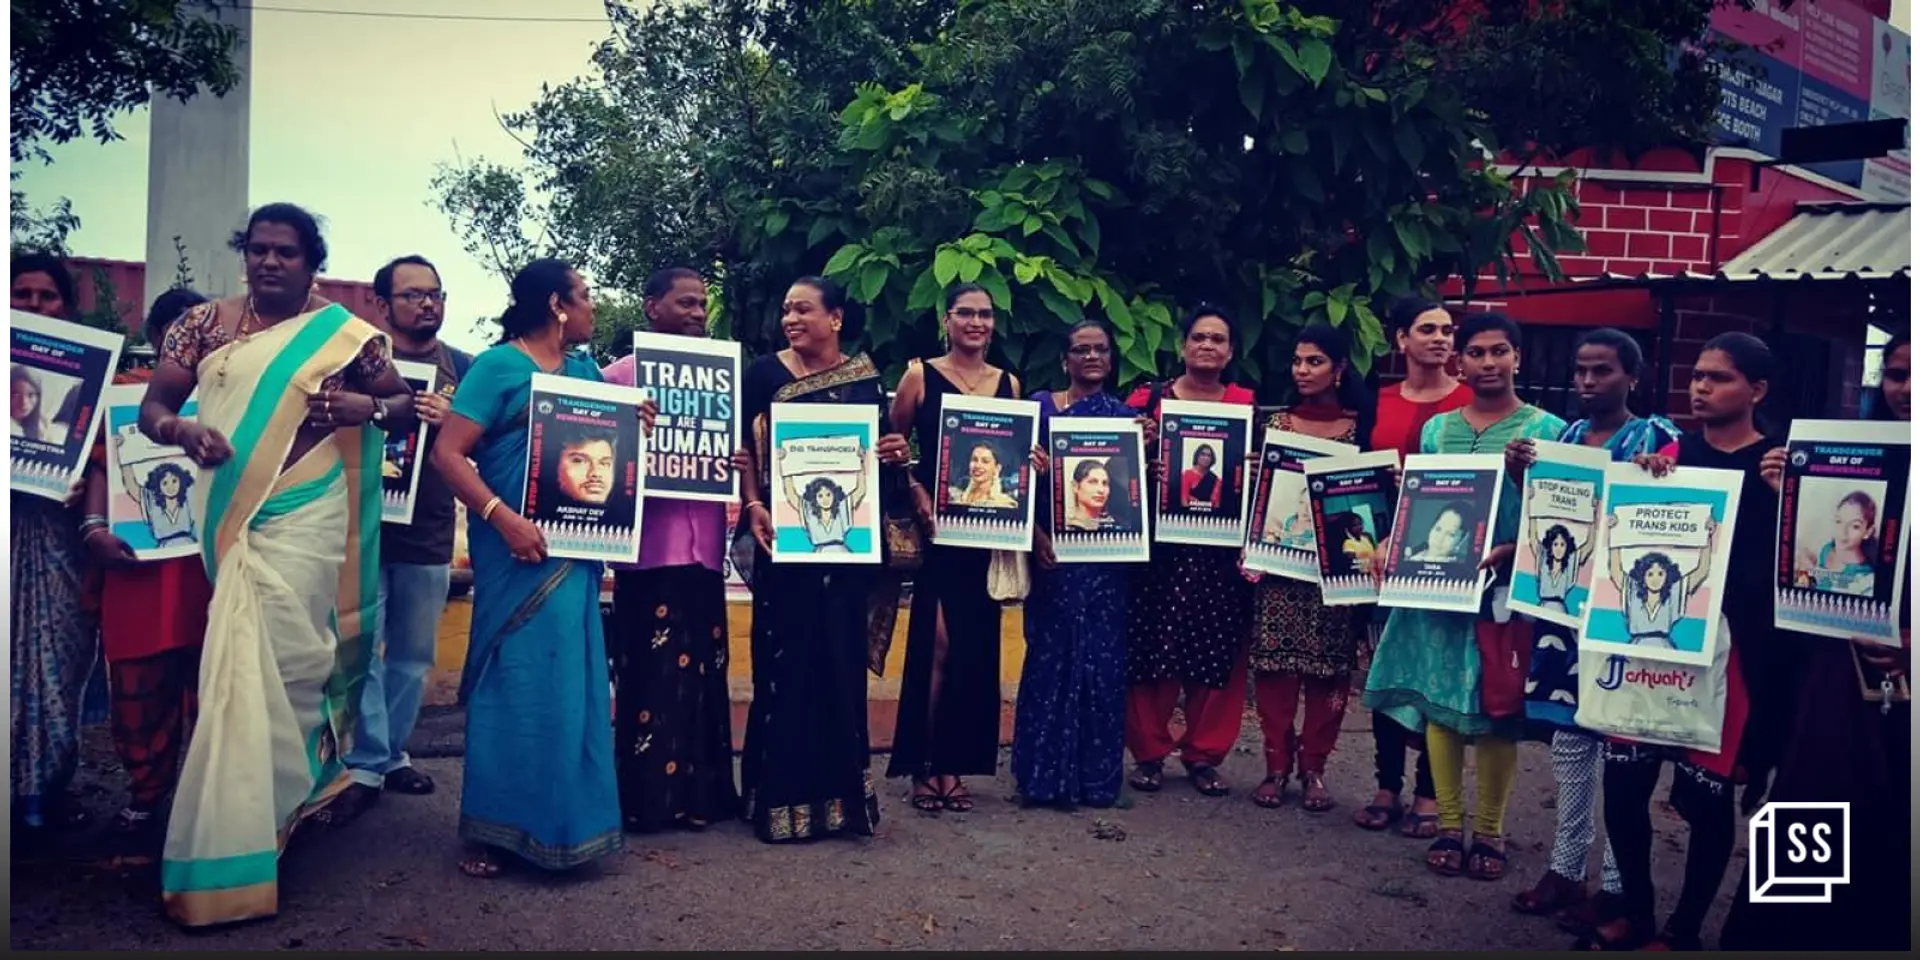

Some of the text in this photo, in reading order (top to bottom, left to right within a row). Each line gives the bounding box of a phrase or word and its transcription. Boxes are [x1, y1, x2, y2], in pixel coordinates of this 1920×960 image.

[1739, 96, 1767, 121] BEACH
[1732, 118, 1761, 142] BOOTH
[51, 349, 65, 357] OF
[641, 361, 731, 393] TRANS
[557, 398, 616, 412] TRANSGENDER
[572, 408, 589, 416] DAY
[963, 413, 1013, 424] TRANSGENDER
[556, 413, 616, 427] REMEMBRANCE
[677, 416, 697, 428] ARE
[1815, 446, 1883, 457] TRANSGENDER
[1829, 456, 1849, 464] DAY
[645, 452, 729, 482] RIGHTS
[1809, 464, 1881, 475] REMEMBRANCE
[1538, 481, 1590, 498] STOP KILLING
[1552, 494, 1577, 507] TRANS
[1636, 508, 1690, 520] PROTECT
[1629, 519, 1698, 533] TRANS KIDS
